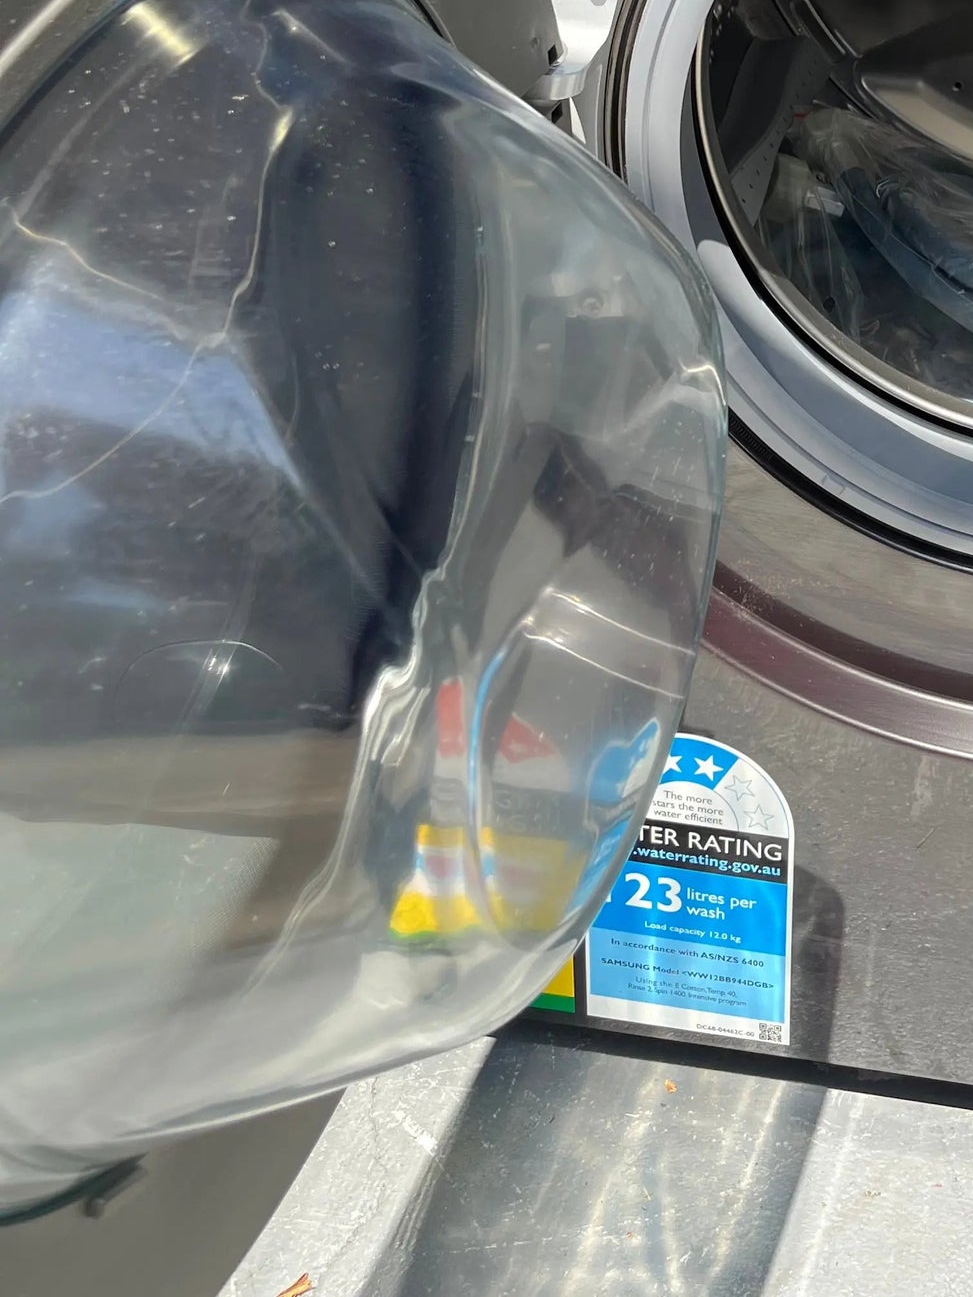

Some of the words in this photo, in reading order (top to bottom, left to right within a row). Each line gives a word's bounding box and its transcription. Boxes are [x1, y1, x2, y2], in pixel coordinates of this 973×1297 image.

[664, 790, 683, 801] The
[686, 795, 713, 806] more
[652, 800, 676, 809] stars
[678, 802, 695, 813] the
[697, 807, 725, 817] more
[653, 809, 682, 820] water
[684, 814, 723, 826] efficient
[638, 825, 680, 847] TER
[688, 831, 783, 861] RATING
[632, 846, 781, 877] .waterrating.gov.au
[608, 872, 683, 914] 23
[686, 887, 725, 905] litres
[730, 896, 757, 910] per
[686, 905, 726, 920] wash
[644, 920, 666, 931] Load
[669, 926, 706, 938] capacity
[709, 930, 728, 941] 12.0
[730, 933, 743, 944] kg
[623, 940, 676, 954] accordance
[678, 950, 699, 958] with
[700, 952, 739, 965] AS/NZS
[741, 958, 765, 968] 6400
[601, 957, 650, 971] SAMSUNG
[653, 965, 679, 975] Model
[628, 983, 646, 992] Rinse
[635, 976, 658, 987] Using
[660, 979, 673, 988] the
